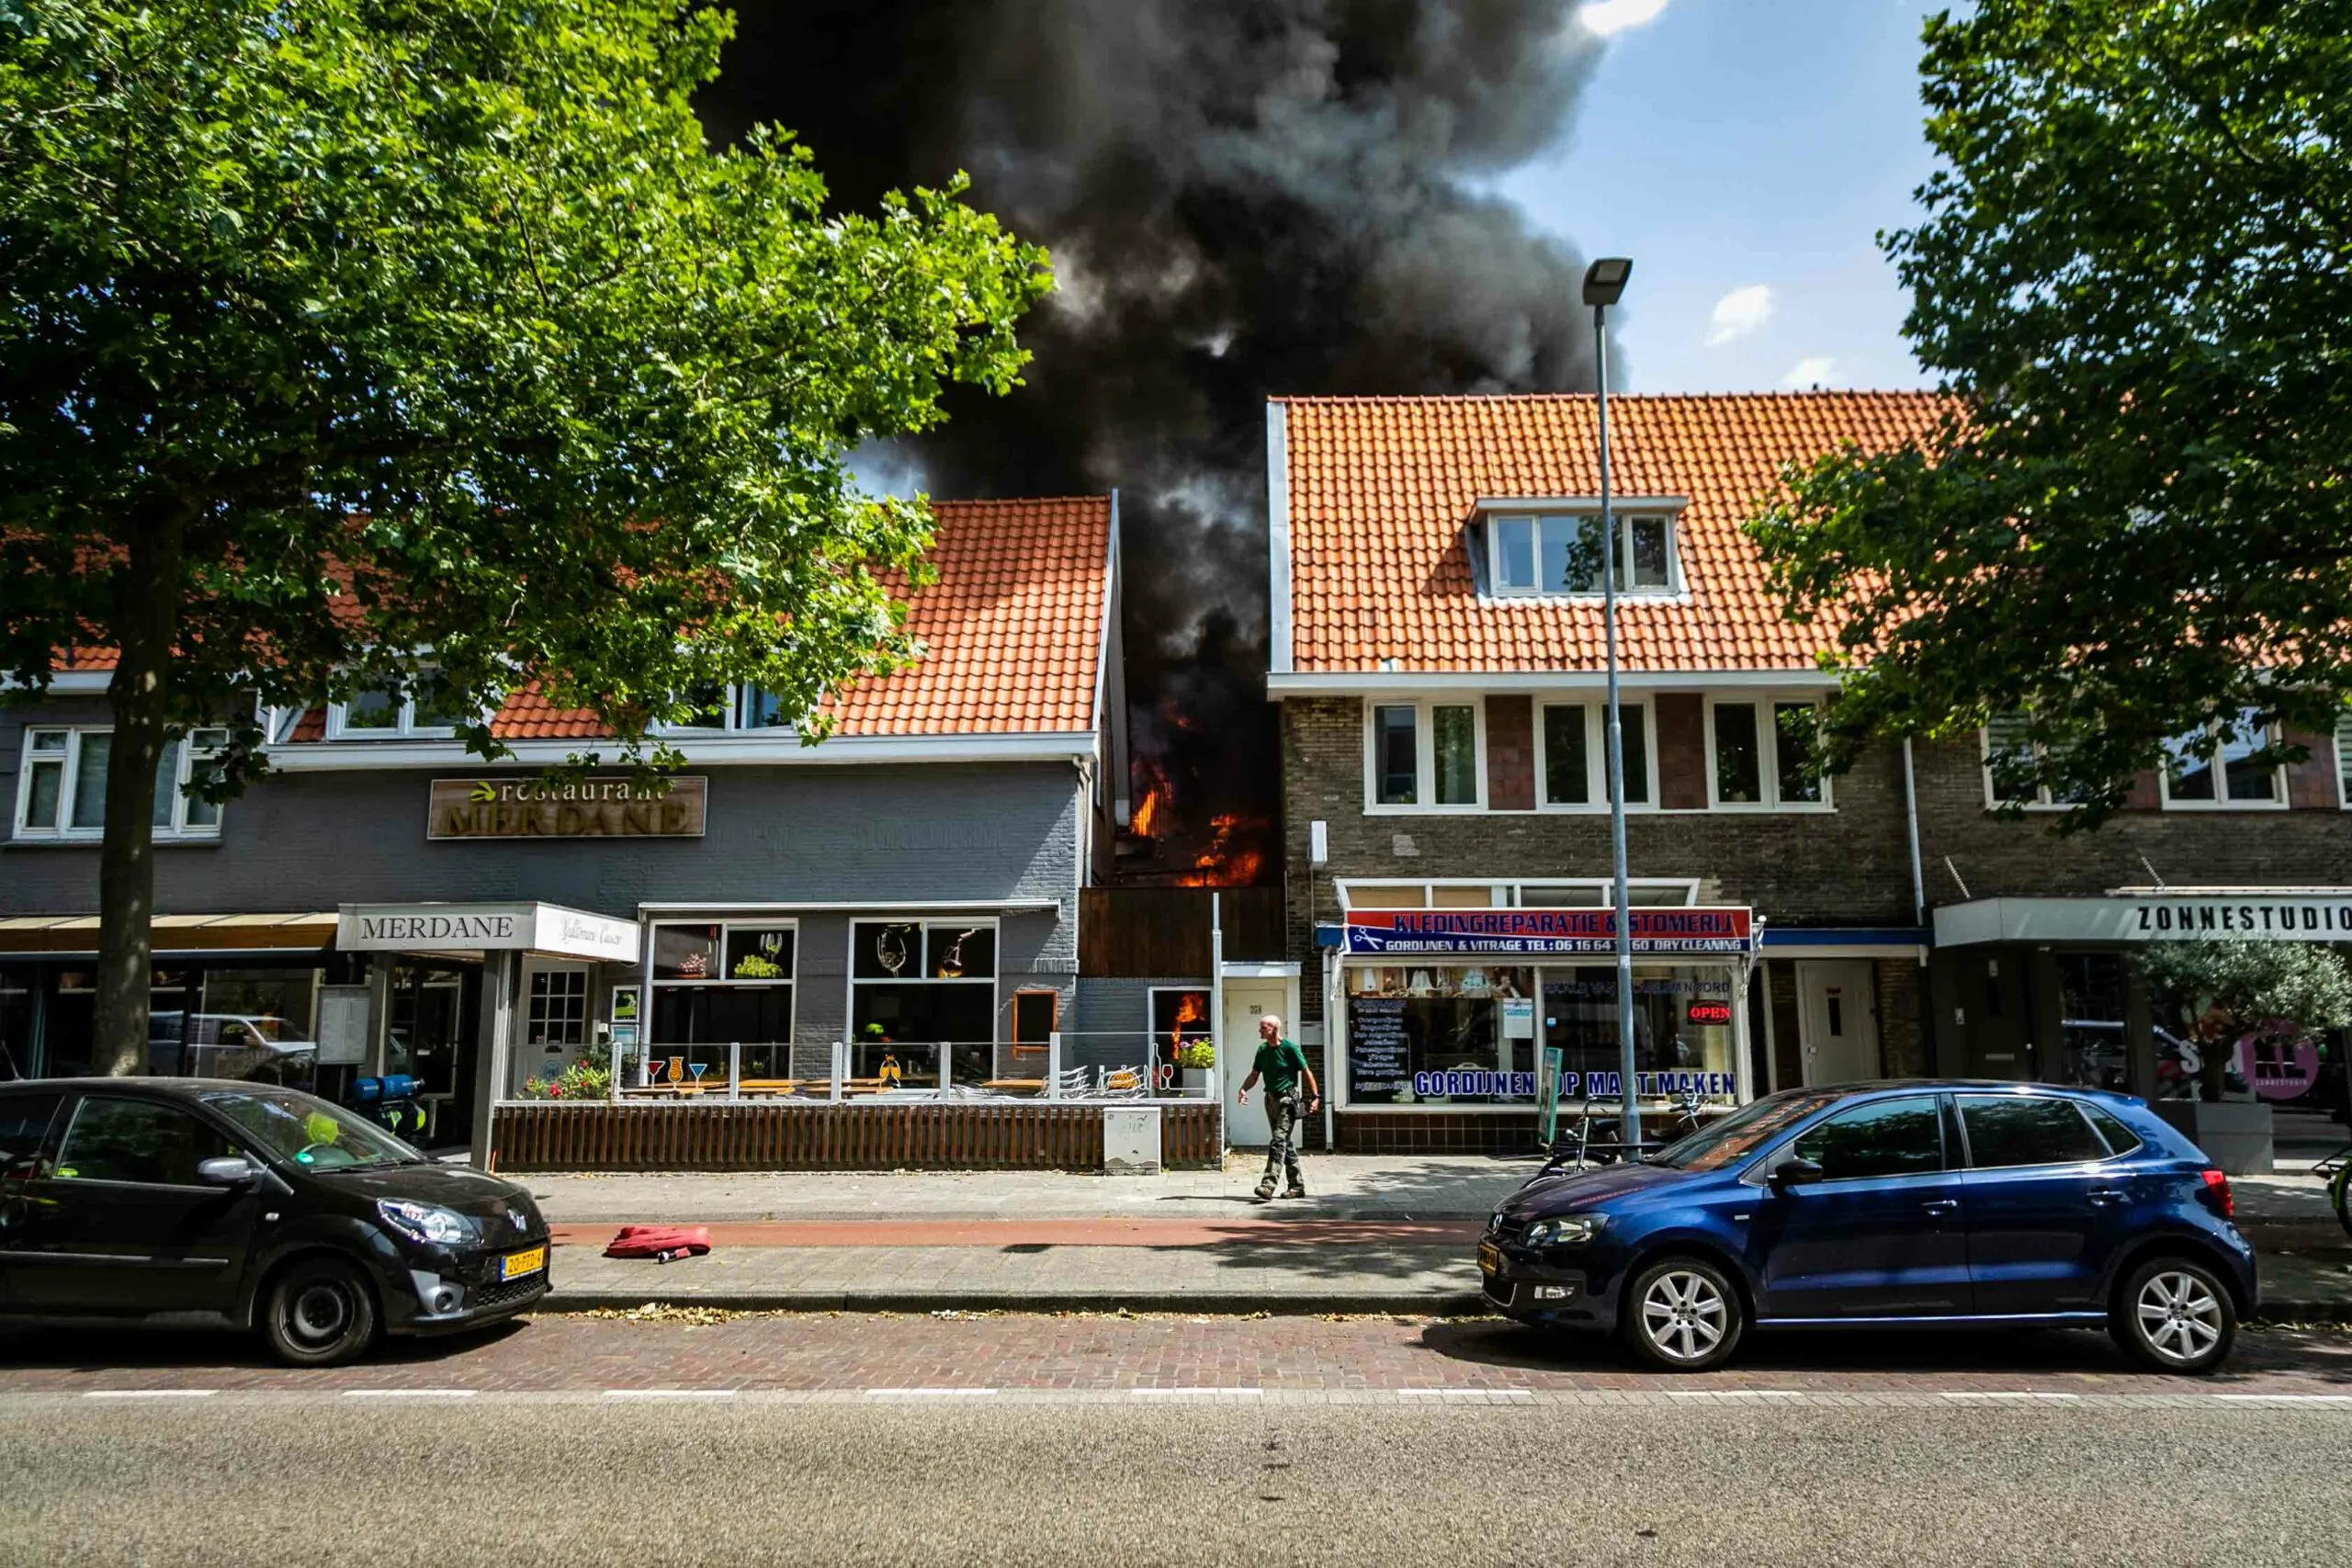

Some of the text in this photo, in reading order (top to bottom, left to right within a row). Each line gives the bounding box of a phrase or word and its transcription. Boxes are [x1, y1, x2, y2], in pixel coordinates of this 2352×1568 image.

[441, 802, 689, 834] MERDANE
[361, 917, 513, 940] MERDANE
[1394, 913, 1600, 933] KLEDINGREPARATIE
[1628, 913, 1733, 933] STOMERIJ
[2137, 906, 2352, 931] ZONNESTUDIO
[1385, 940, 1453, 952] GORDIJNEN
[1457, 940, 1468, 952] &
[1470, 940, 1521, 952] VITRAGE
[1576, 940, 1591, 952] 16
[1593, 940, 1611, 952] 64
[1654, 940, 1681, 952] DRY
[1681, 939, 1742, 951] CLEANING
[1690, 1006, 1731, 1020] OPEN
[1415, 1071, 1535, 1096] GORDIJNEN
[1587, 1071, 1649, 1096] MAT
[1656, 1071, 1736, 1096] MAKEN
